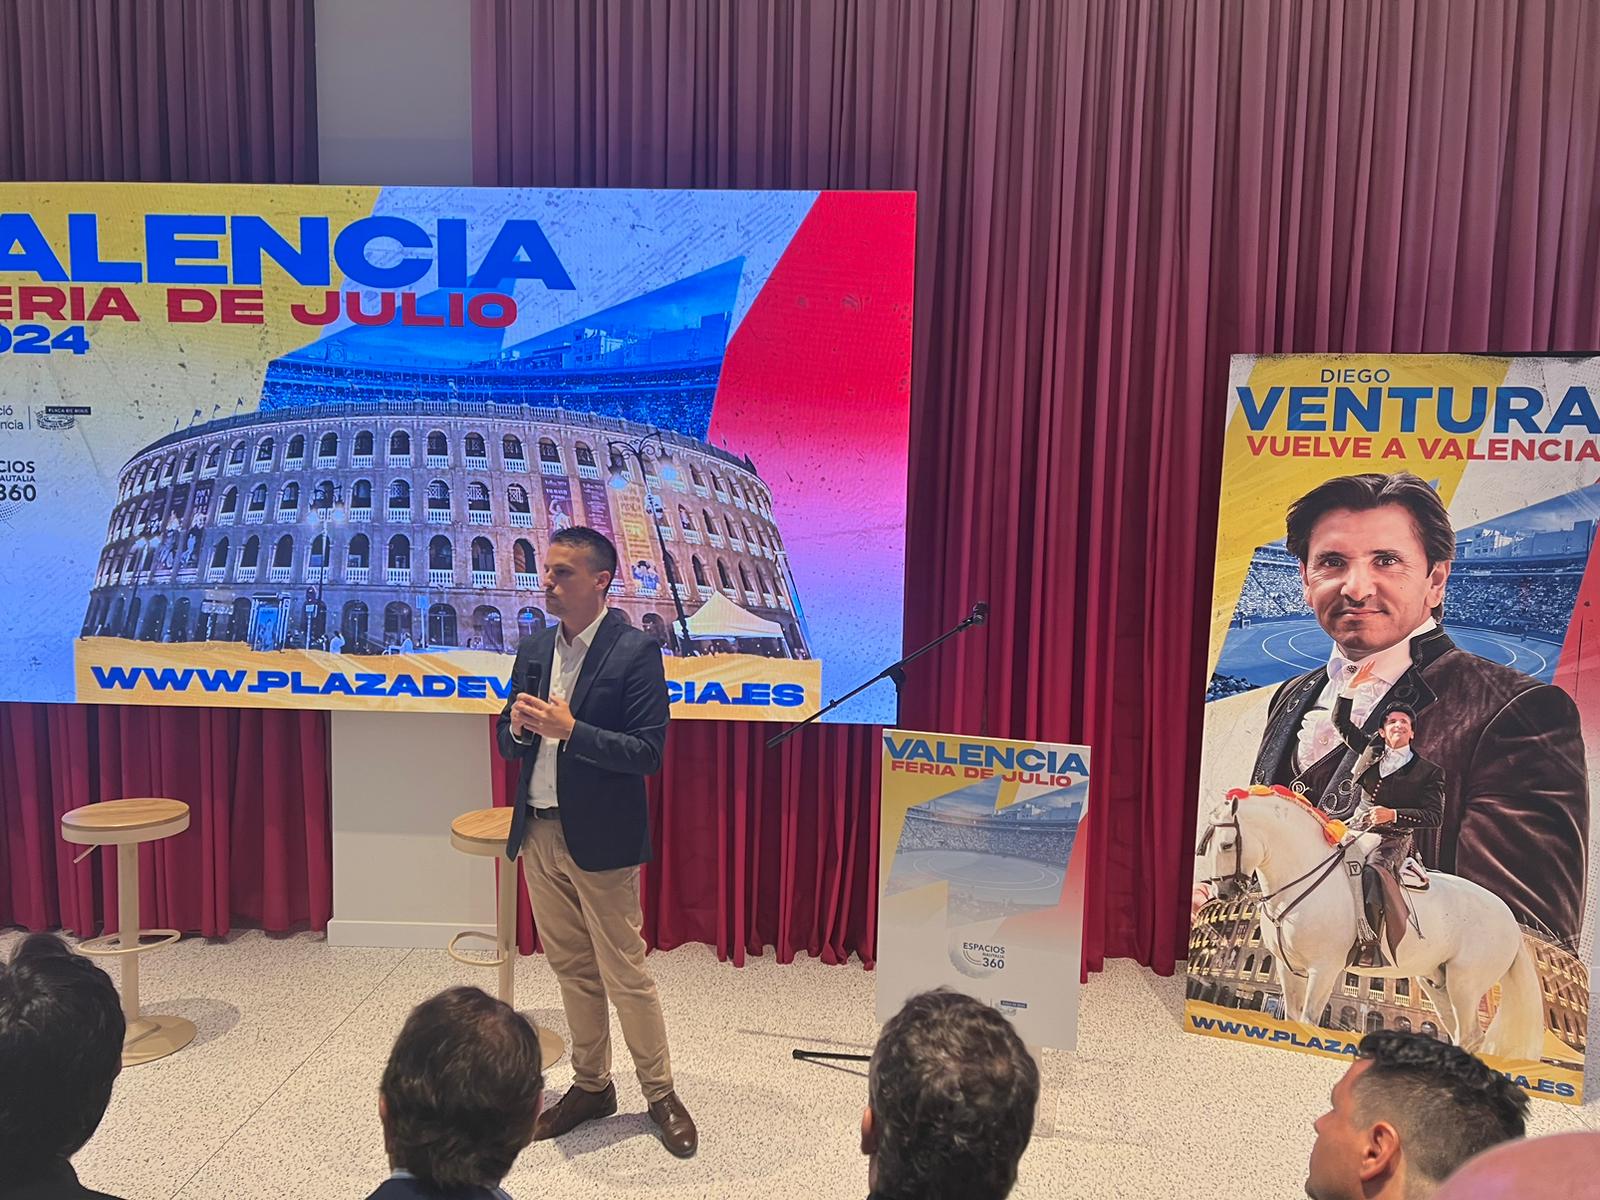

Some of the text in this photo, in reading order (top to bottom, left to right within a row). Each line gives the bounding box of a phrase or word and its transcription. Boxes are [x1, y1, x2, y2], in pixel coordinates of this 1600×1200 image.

[0, 286, 518, 328] RIA DE JULIO
[0, 324, 90, 355] 24
[1320, 368, 1391, 383] DIEGO
[1236, 386, 1600, 434] VENTURA
[1246, 436, 1600, 462] VUELVE A VALENCIA
[883, 736, 1090, 776] VALENCIA
[891, 760, 1072, 788] FERIA DE JULIO
[963, 942, 1006, 955] ESPACIOS
[982, 957, 1005, 969] 360
